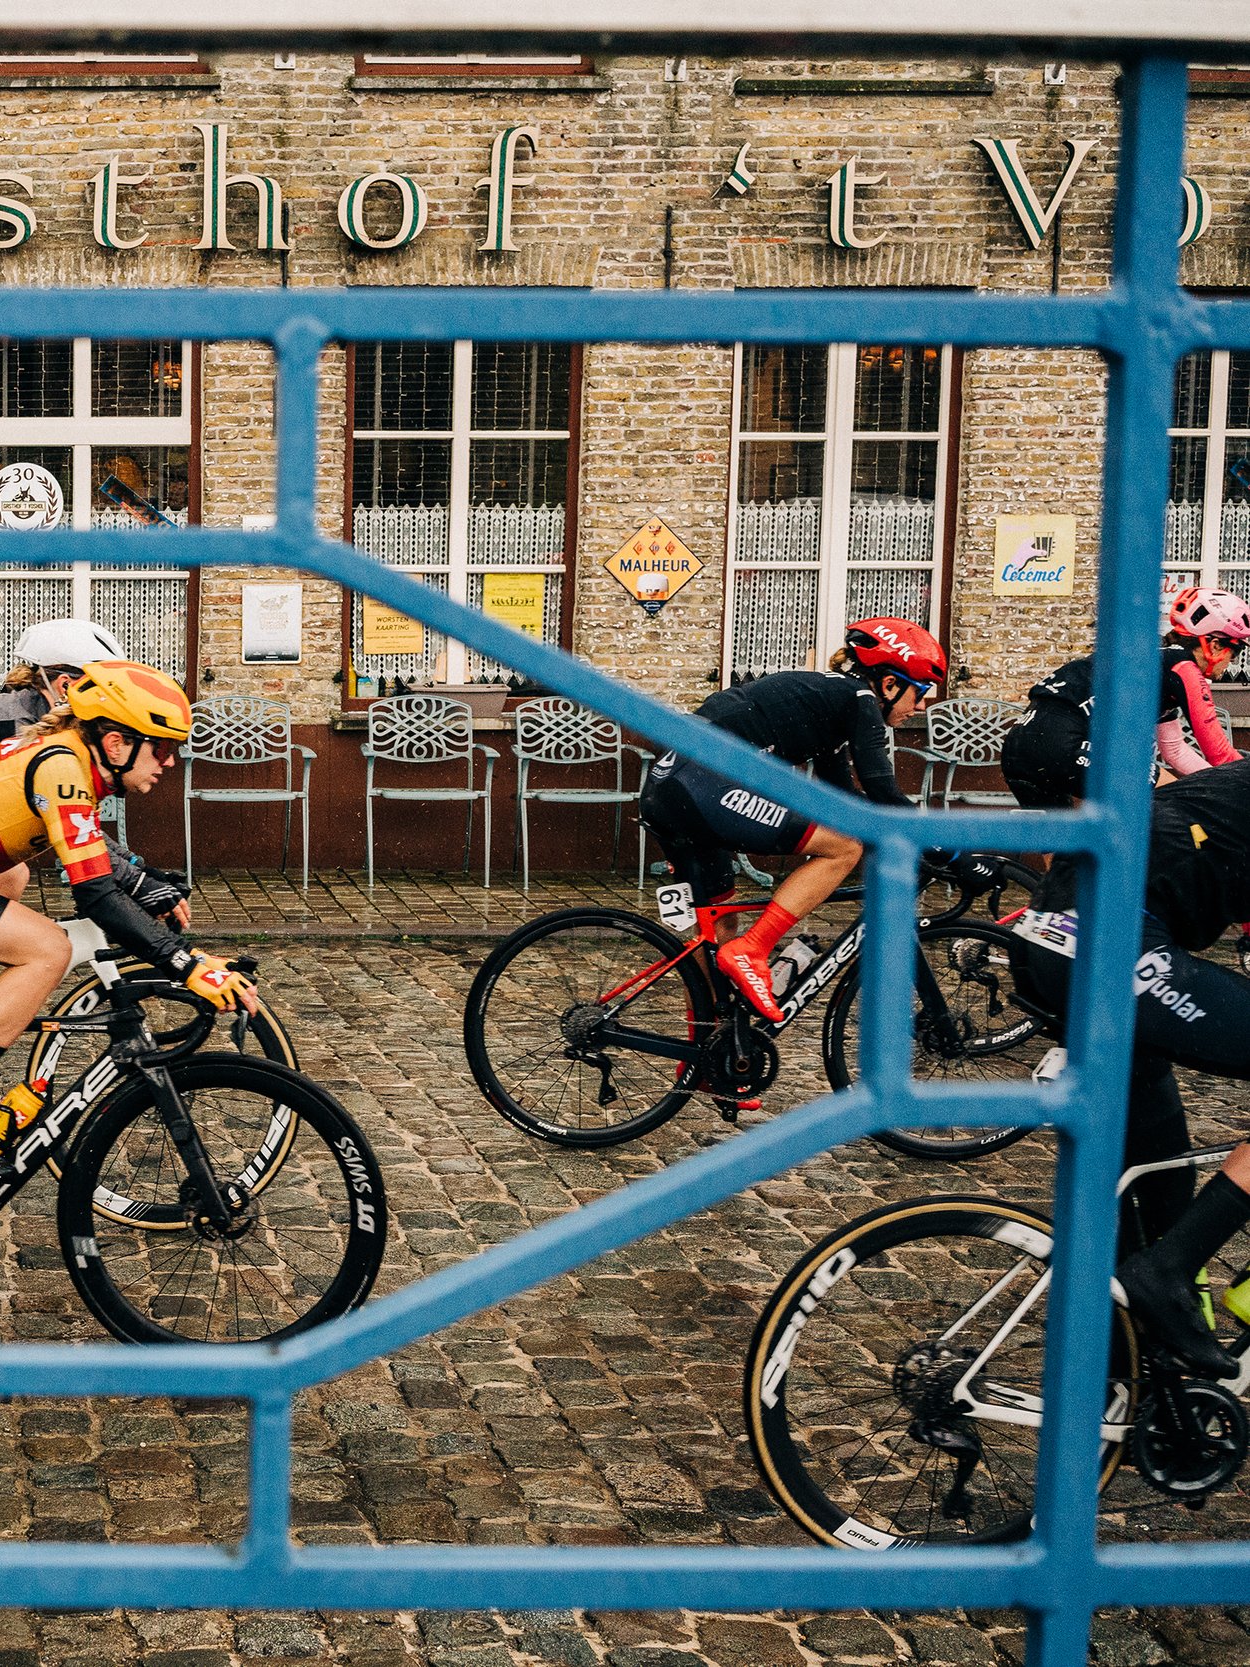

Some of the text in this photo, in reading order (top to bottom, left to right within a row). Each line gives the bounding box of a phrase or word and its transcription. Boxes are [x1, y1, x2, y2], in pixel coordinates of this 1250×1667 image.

[11, 467, 35, 483] 30
[619, 558, 692, 573] MALHEUR
[872, 625, 918, 663] KASK
[720, 788, 789, 828] CERATIZIT
[659, 889, 686, 920] 61
[537, 1121, 568, 1136] Vision
[334, 1136, 376, 1235] DT SWISS
